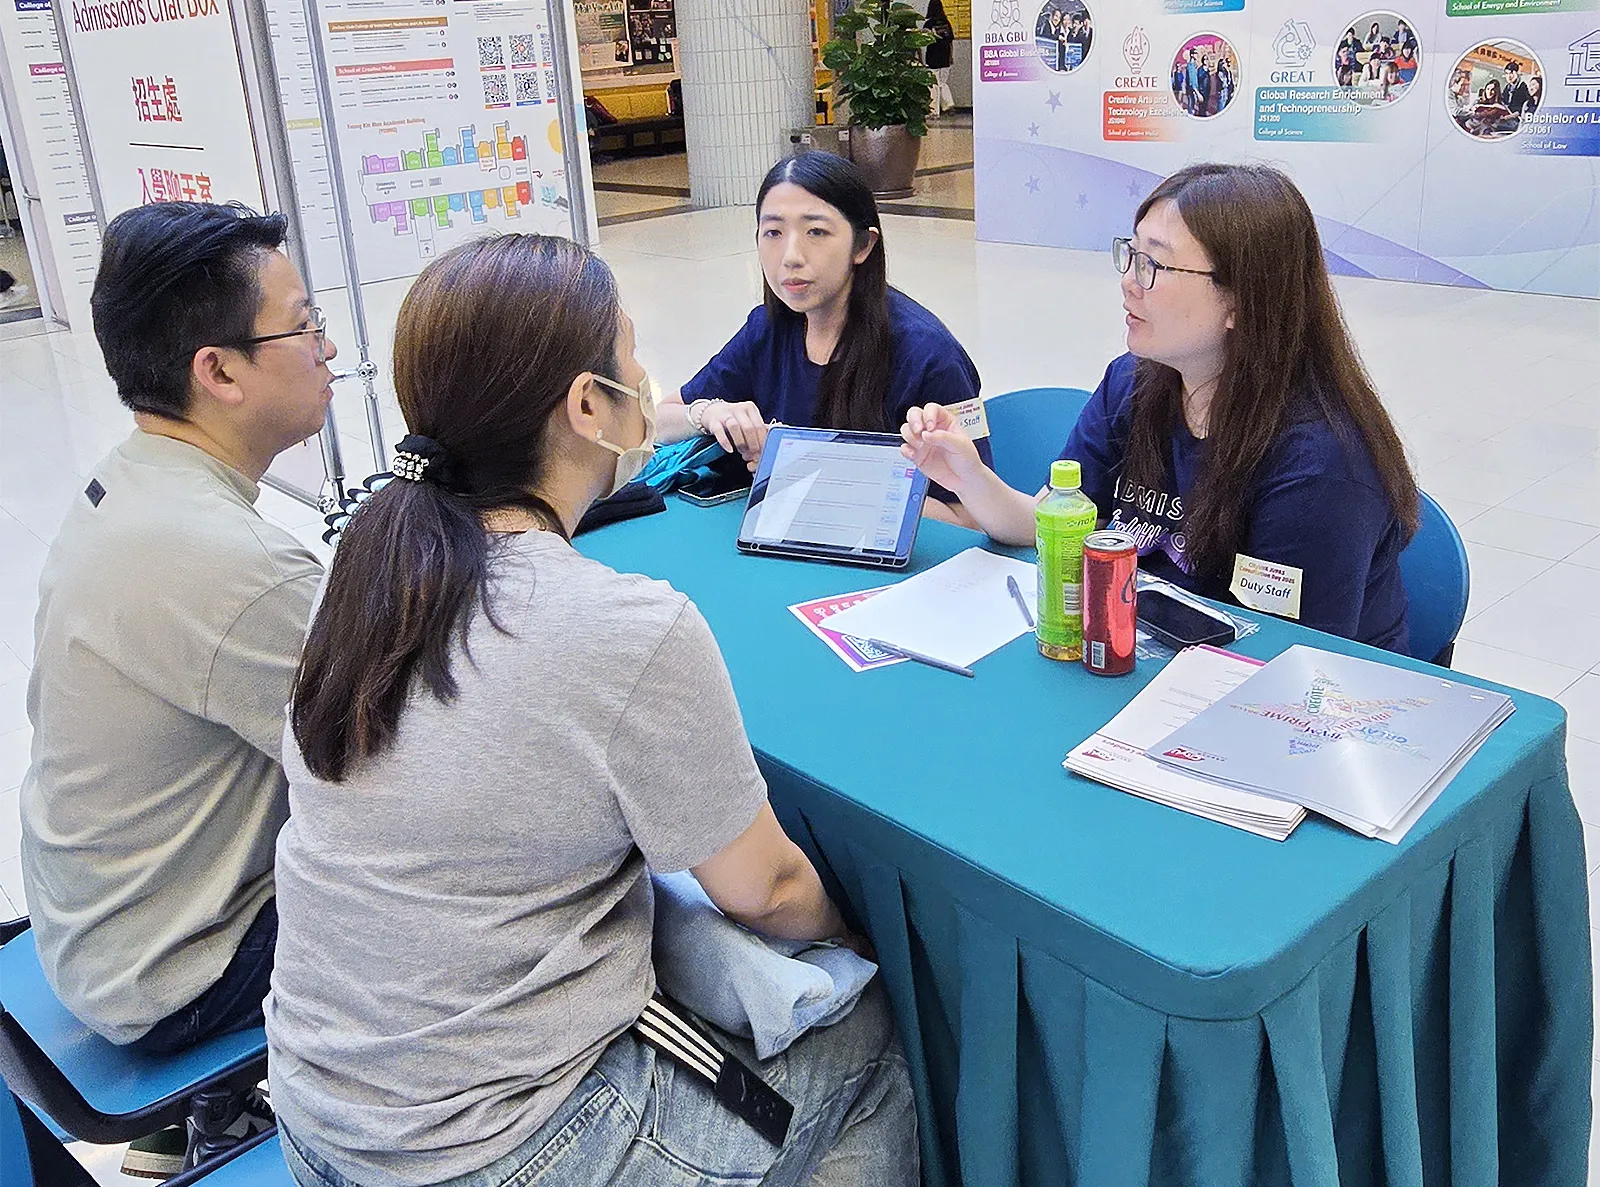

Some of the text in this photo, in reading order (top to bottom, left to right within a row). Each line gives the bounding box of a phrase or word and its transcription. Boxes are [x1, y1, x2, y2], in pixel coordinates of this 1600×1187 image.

[1482, 1, 1504, 10] Energy
[1505, 0, 1518, 8] and
[73, 0, 147, 33] Admissions
[148, 0, 184, 23] Chat
[985, 31, 1028, 43] BBA GBU
[1115, 76, 1158, 88] CREATE
[1270, 70, 1315, 83] GREAT
[131, 75, 183, 122] 招生處
[1108, 95, 1137, 104] Creative
[1260, 89, 1385, 100] Global Research Enrichment
[1108, 107, 1148, 118] Technology
[1259, 103, 1361, 116] and Technopreneurship
[1525, 112, 1574, 123] Bachelor
[1576, 112, 1589, 123] of
[1240, 577, 1292, 599] Duty Staff
